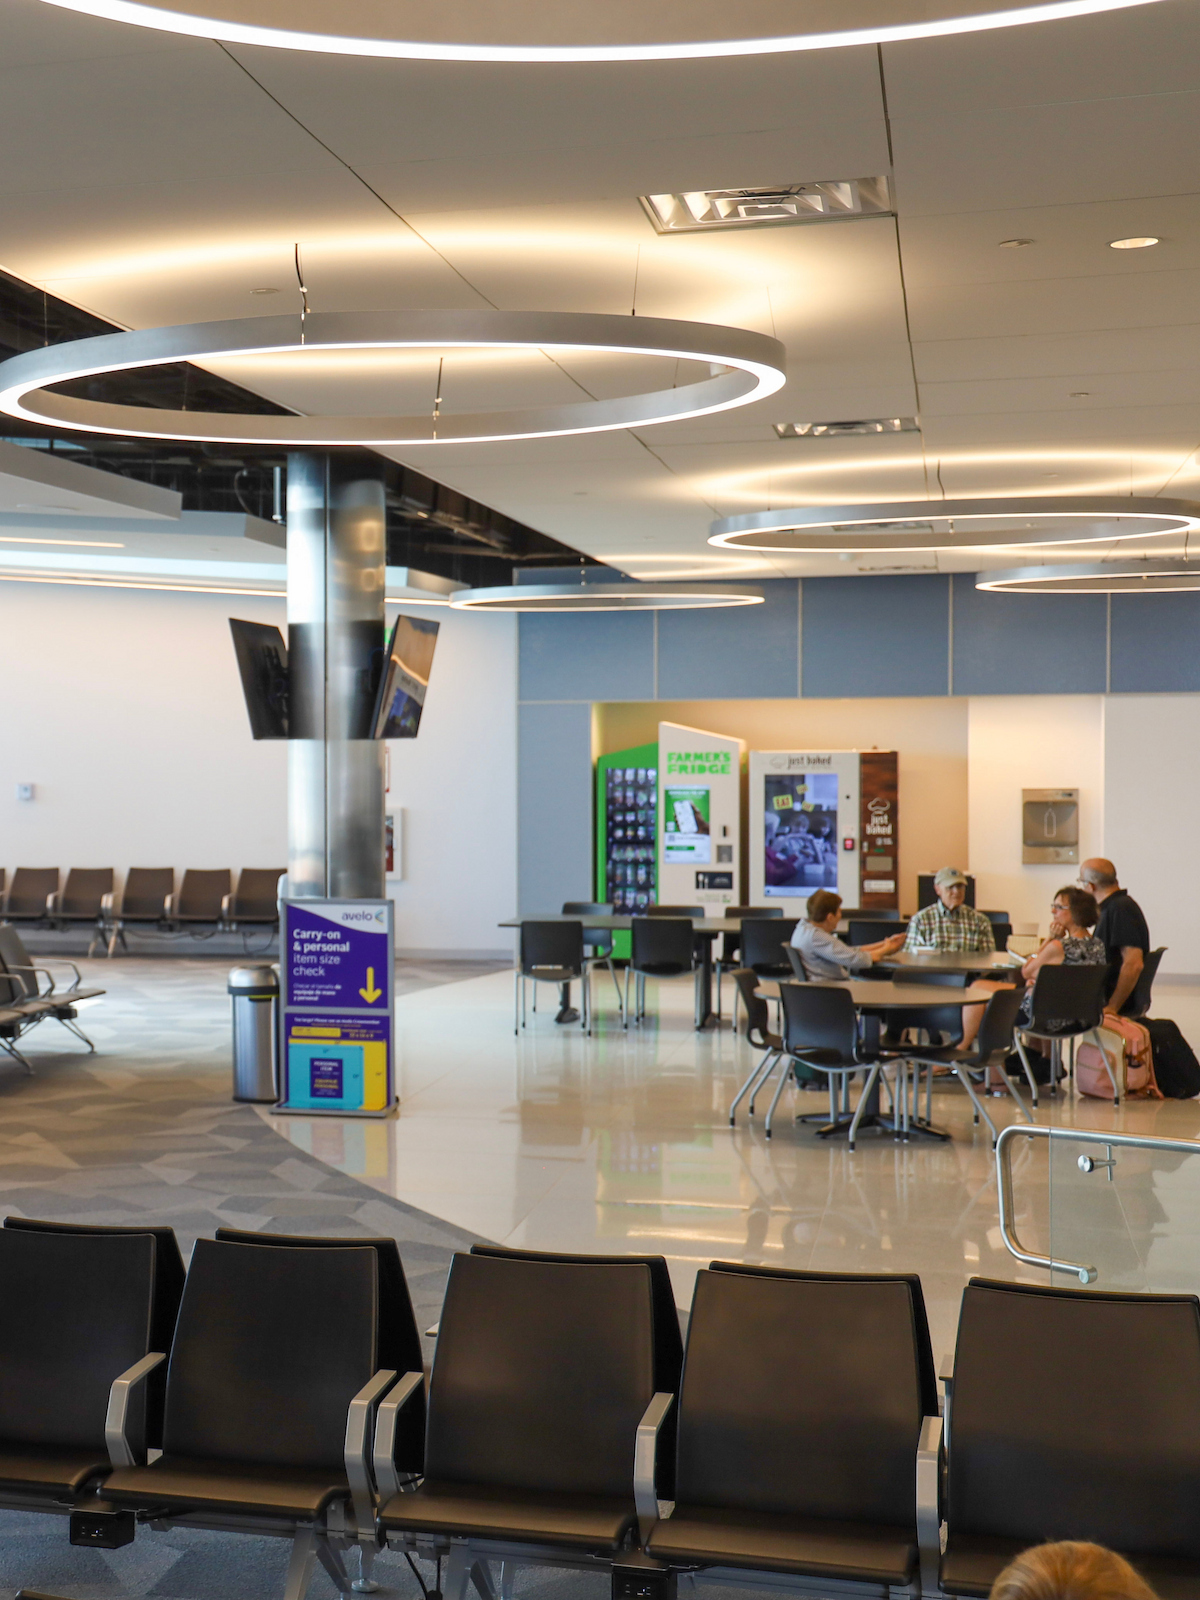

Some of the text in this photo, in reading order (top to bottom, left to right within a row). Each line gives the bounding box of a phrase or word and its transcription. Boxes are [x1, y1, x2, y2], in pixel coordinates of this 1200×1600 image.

[667, 751, 731, 762] FARMER'S
[788, 756, 832, 769] just baked
[667, 764, 731, 774] FRIDGE
[871, 814, 888, 826] just
[866, 824, 892, 835] baked
[342, 911, 373, 921] avelo
[293, 929, 341, 941] Carry-on
[293, 941, 350, 953] & personal
[293, 953, 340, 965] item size
[293, 966, 325, 976] check
